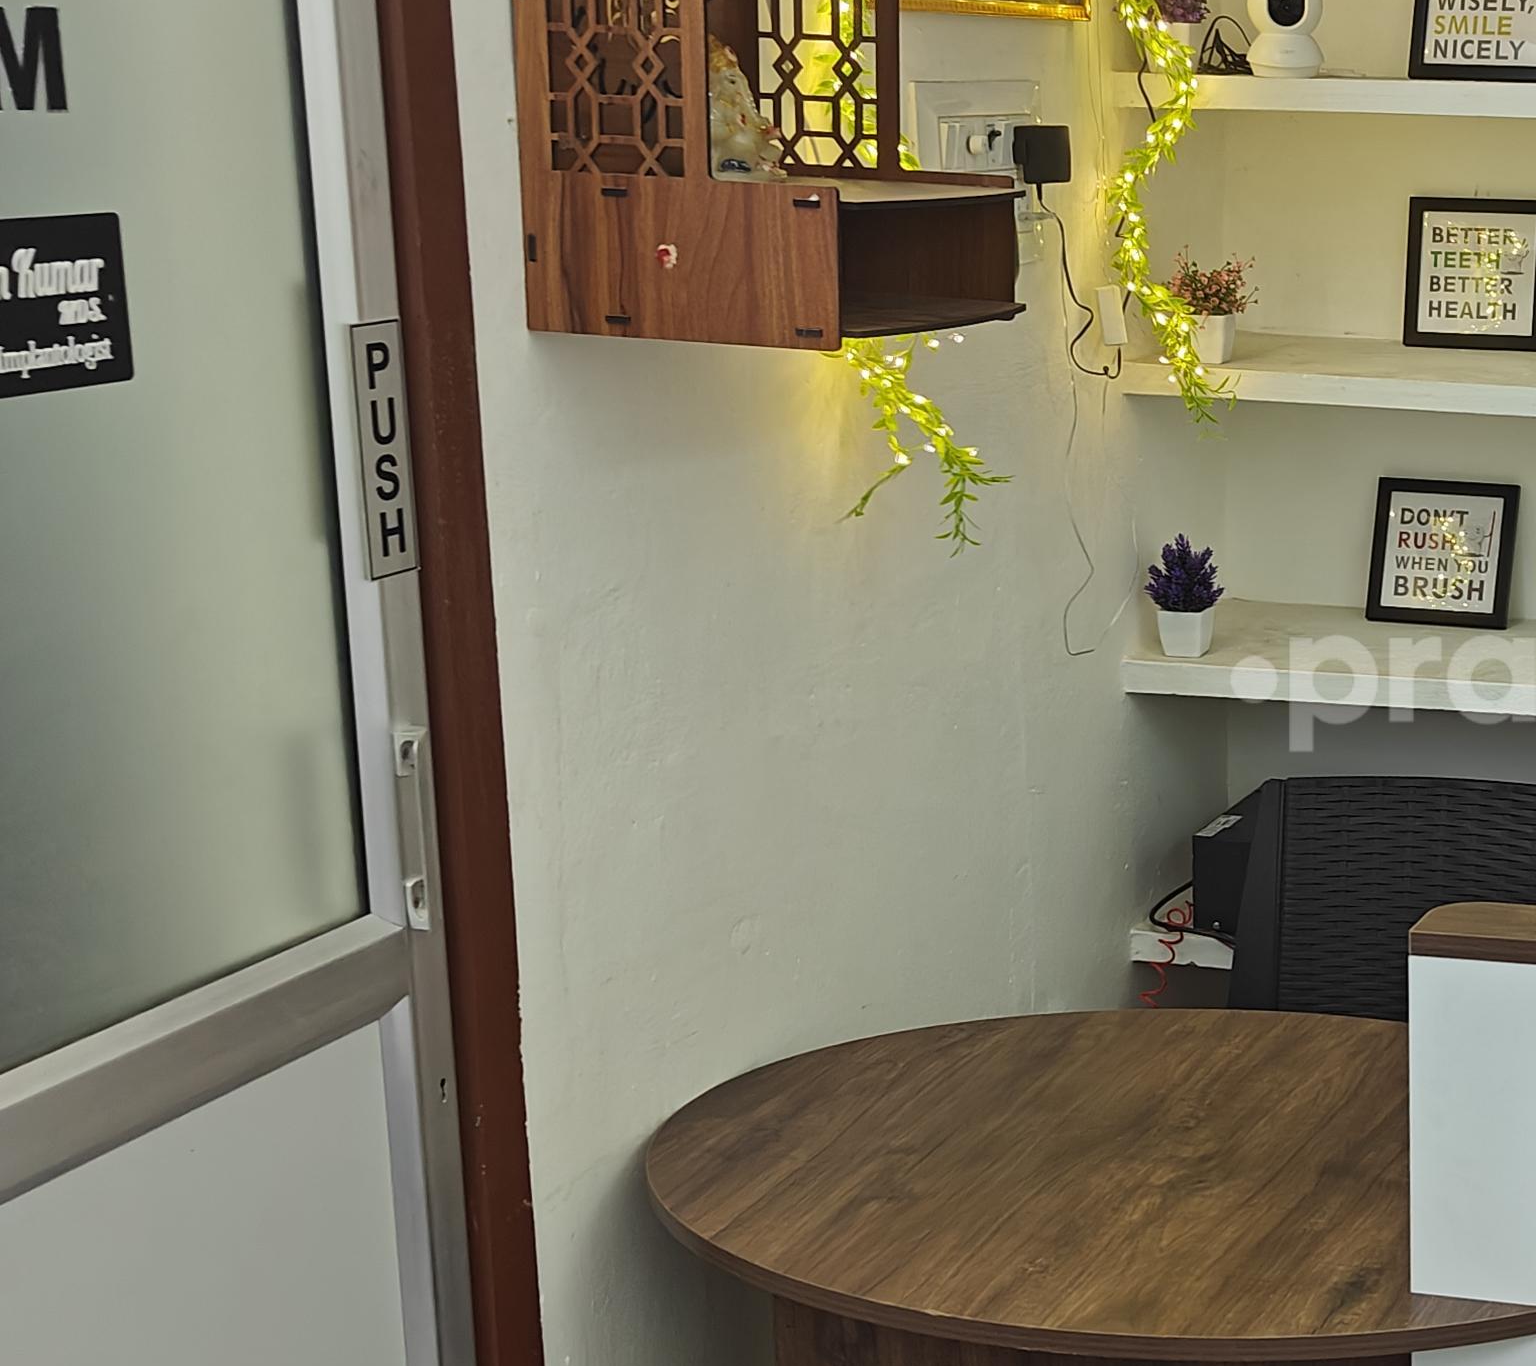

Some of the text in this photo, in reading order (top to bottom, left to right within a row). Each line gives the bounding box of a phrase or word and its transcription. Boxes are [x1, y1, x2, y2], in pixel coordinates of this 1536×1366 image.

[1434, 15, 1513, 35] SMILE
[1433, 39, 1525, 60] NICELY
[1432, 226, 1514, 245] BETTER
[1430, 250, 1500, 269] TEETH
[1429, 275, 1513, 294] BETTER
[1428, 300, 1517, 320] HEALTH
[366, 342, 406, 557] PUSH
[1398, 531, 1457, 550] RUSH
[1395, 556, 1489, 574] WHEN YOU
[1393, 576, 1485, 601] BRUSH
